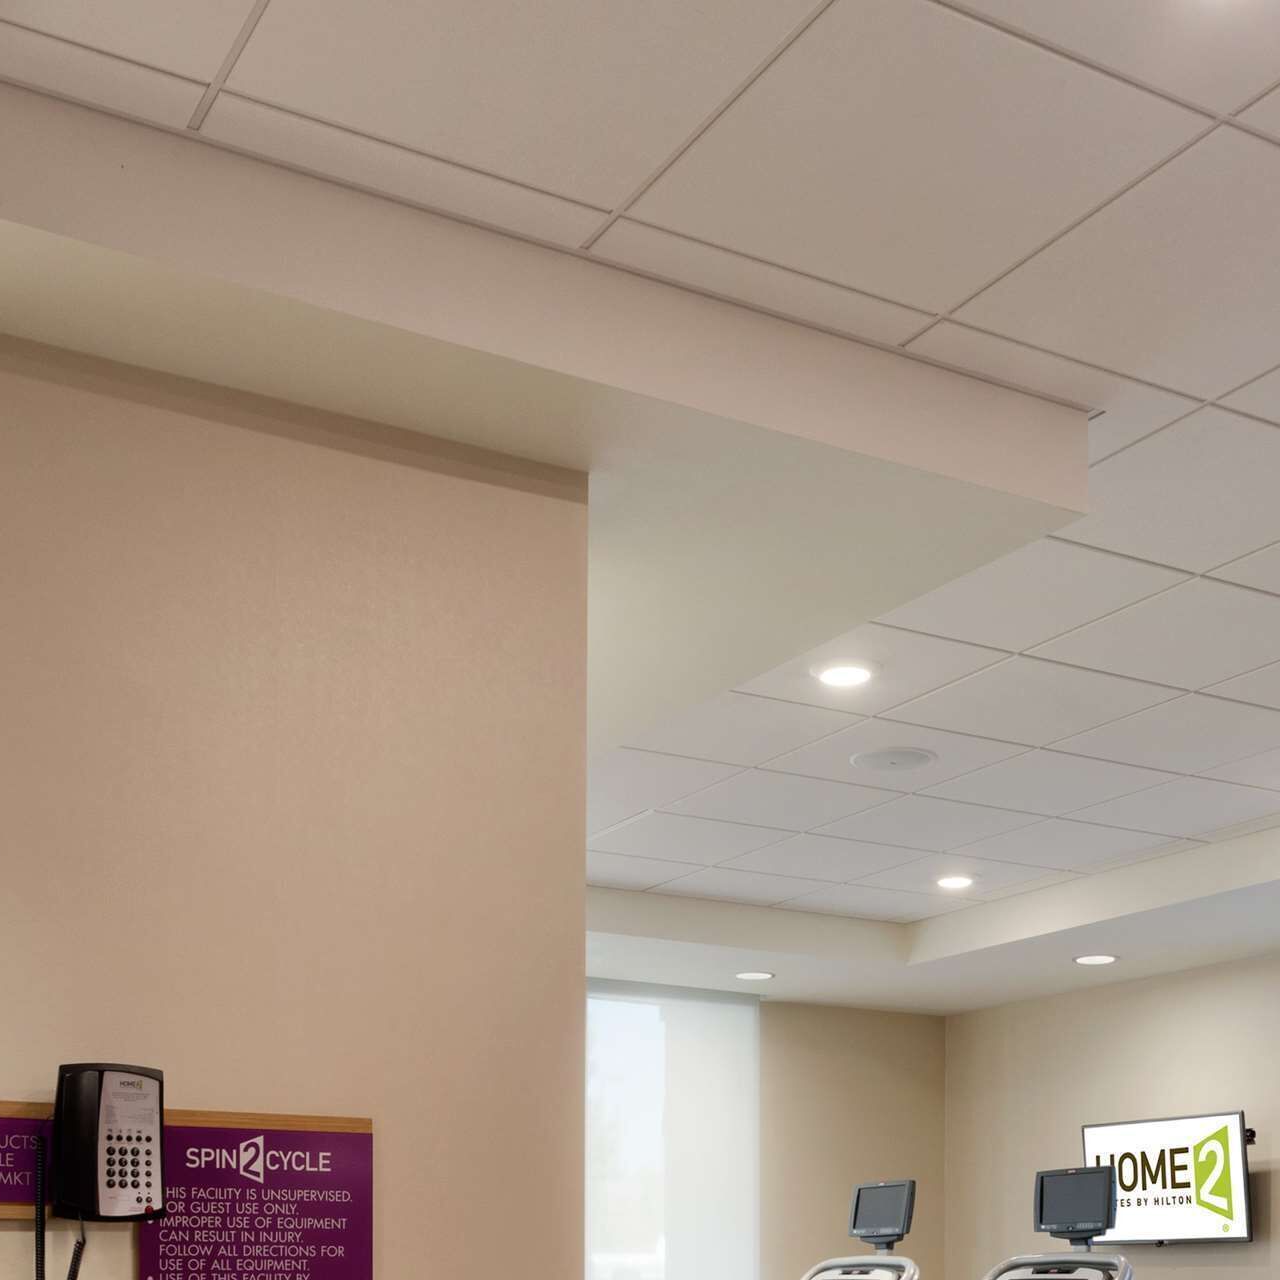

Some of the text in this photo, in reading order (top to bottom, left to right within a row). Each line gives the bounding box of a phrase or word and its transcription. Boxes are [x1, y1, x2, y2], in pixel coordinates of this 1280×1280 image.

[166, 1187, 352, 1202] HIS FACILITY IS UNSUPERVISED.
[1137, 1198, 1148, 1206] BY
[1154, 1195, 1192, 1206] HILTON
[167, 1202, 299, 1215] OR GUEST USE ONLY.
[160, 1216, 347, 1229] IMPROPER USE OF EQUIPMENT
[159, 1231, 303, 1243] CAN RESULT IN INJURY.
[160, 1245, 344, 1257] FOLLOW ALL DIRECTIONS FOR
[160, 1259, 309, 1271] USE OF ALL EQUIPMENT.
